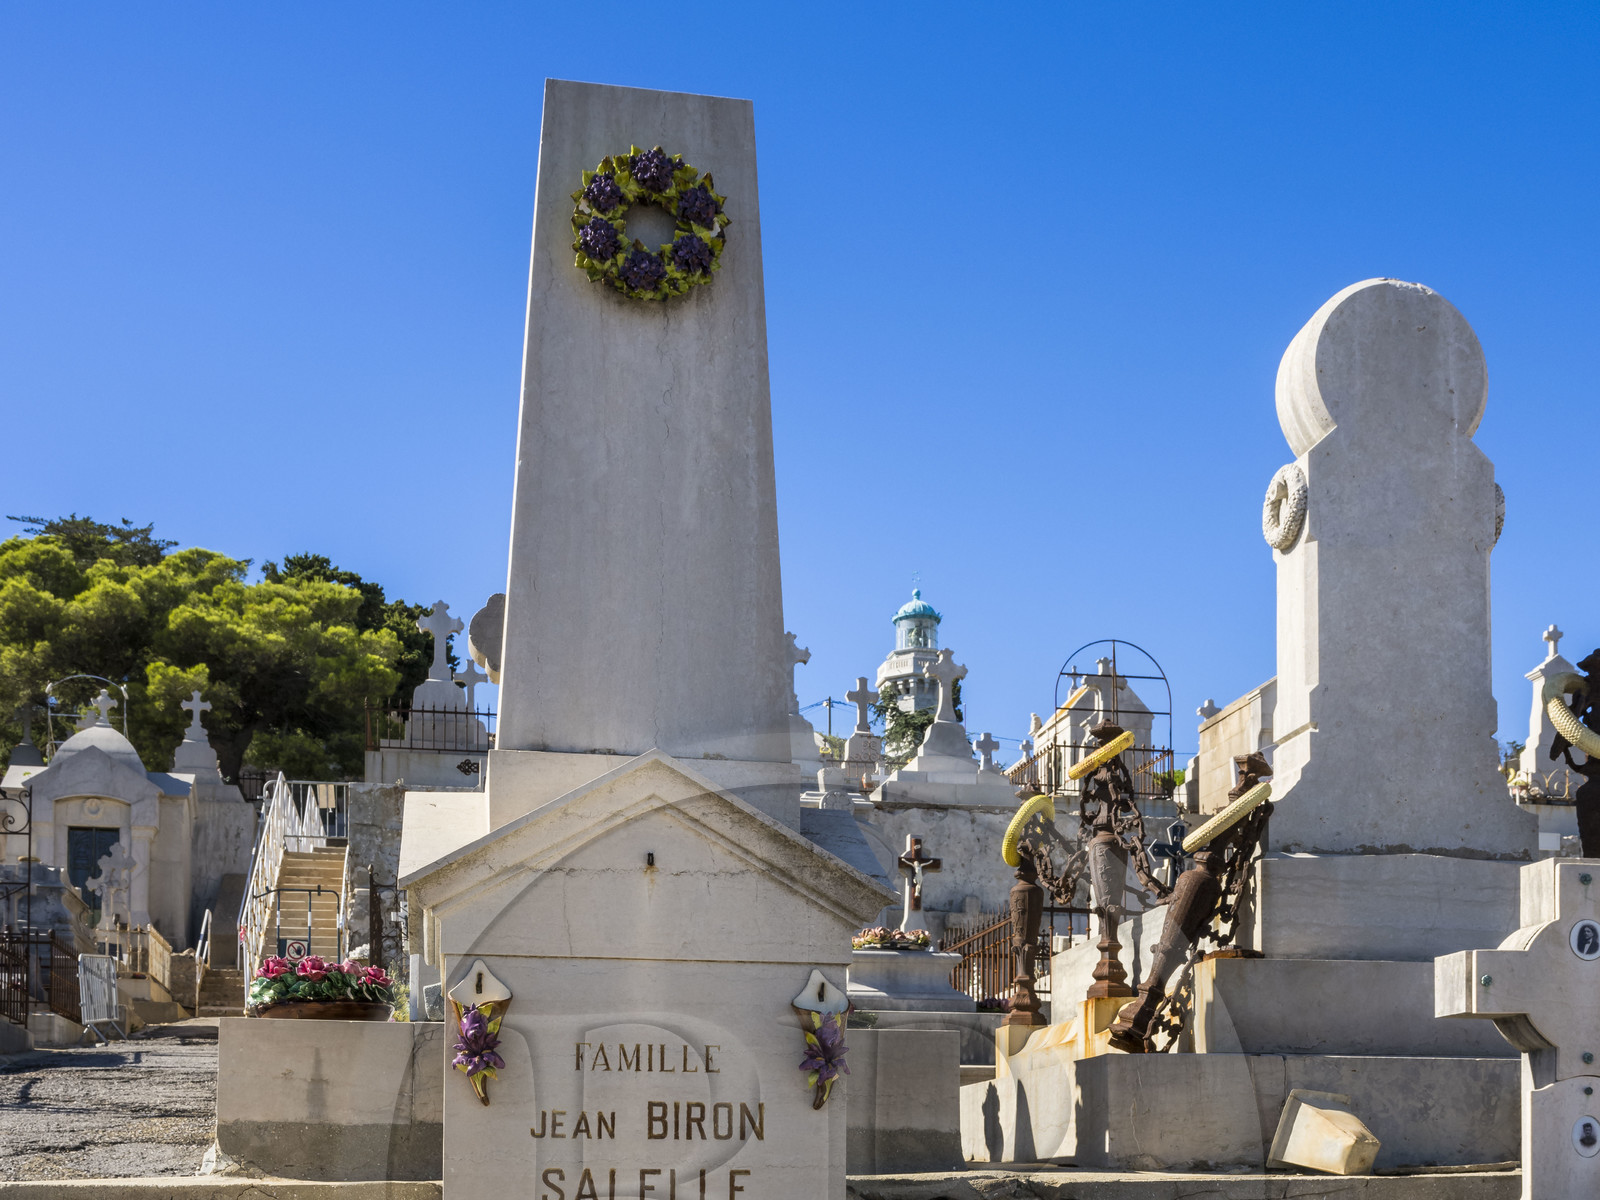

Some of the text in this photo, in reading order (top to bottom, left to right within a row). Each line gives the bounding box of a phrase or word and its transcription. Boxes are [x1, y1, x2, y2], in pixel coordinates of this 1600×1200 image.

[574, 1042, 721, 1074] FAMILLE
[530, 1101, 765, 1141] JEAN BIRON
